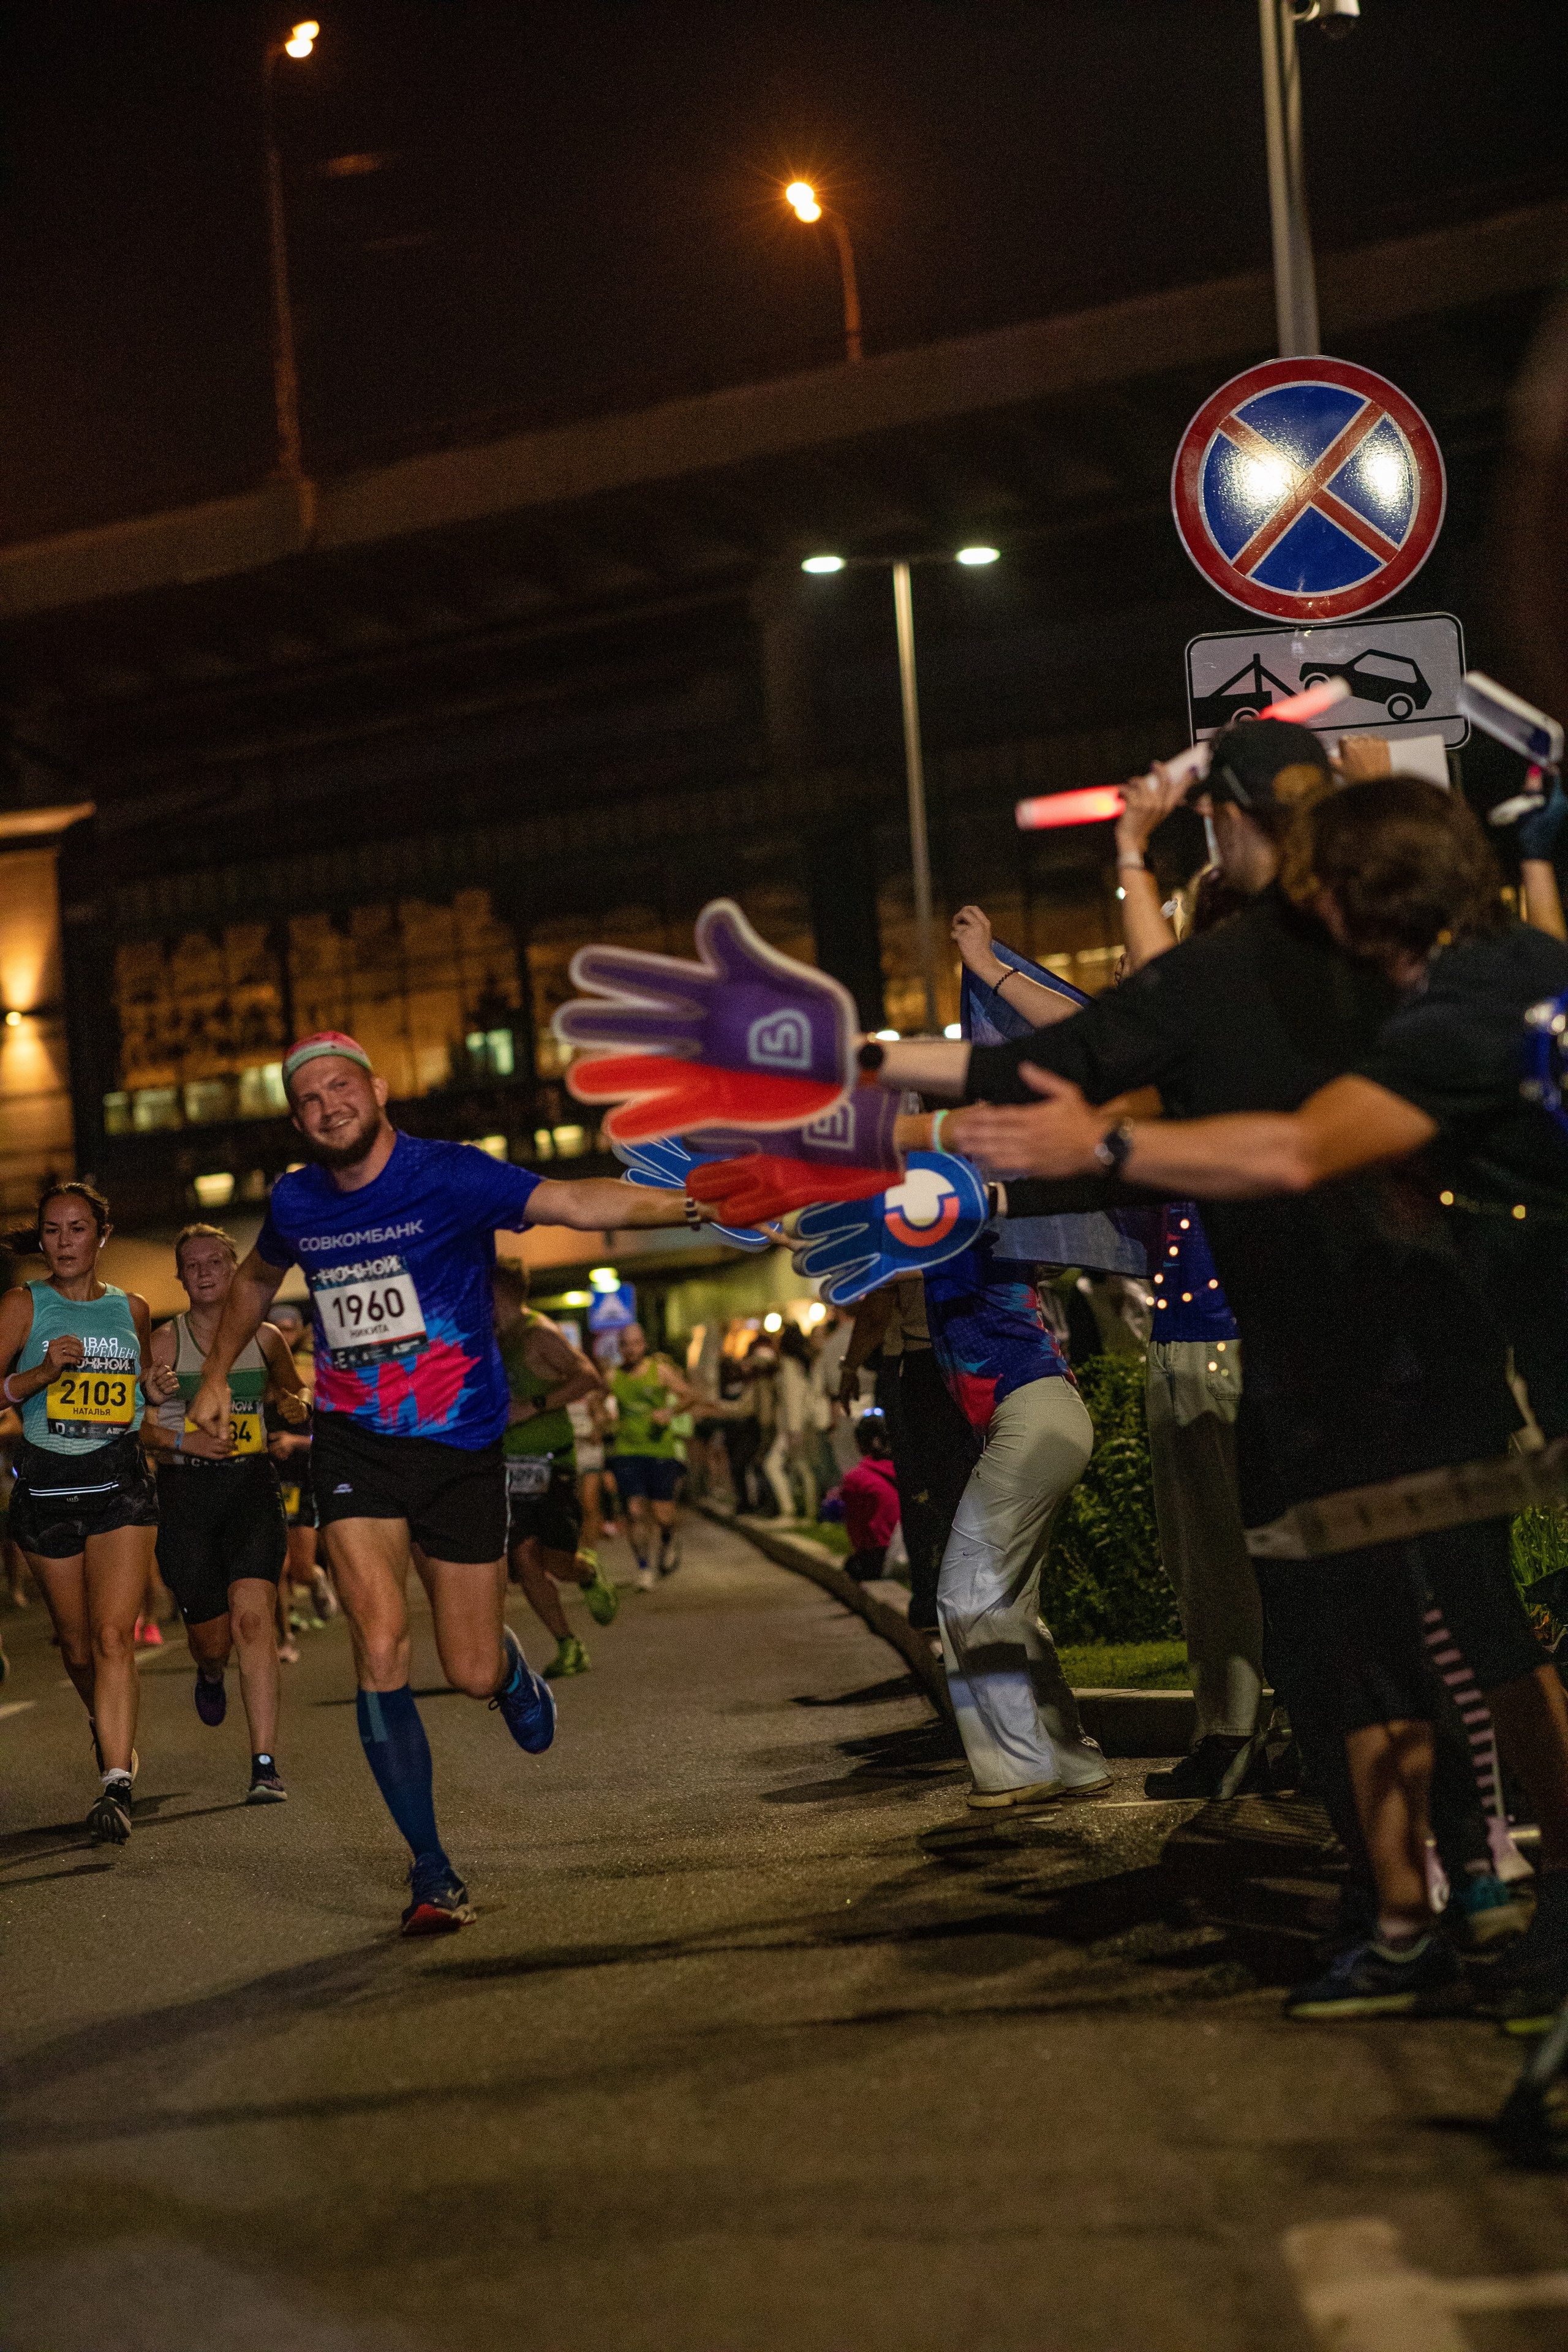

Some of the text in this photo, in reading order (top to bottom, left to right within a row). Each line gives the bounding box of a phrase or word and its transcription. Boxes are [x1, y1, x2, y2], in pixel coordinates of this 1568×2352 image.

[299, 1219, 424, 1252] СОВКОМБАНК
[332, 1287, 404, 1328] 1960
[350, 1324, 390, 1338] НИКИТА
[42, 1336, 118, 1352] ЗВАЯ
[60, 1379, 126, 1406] 2103
[230, 1420, 252, 1442] 34
